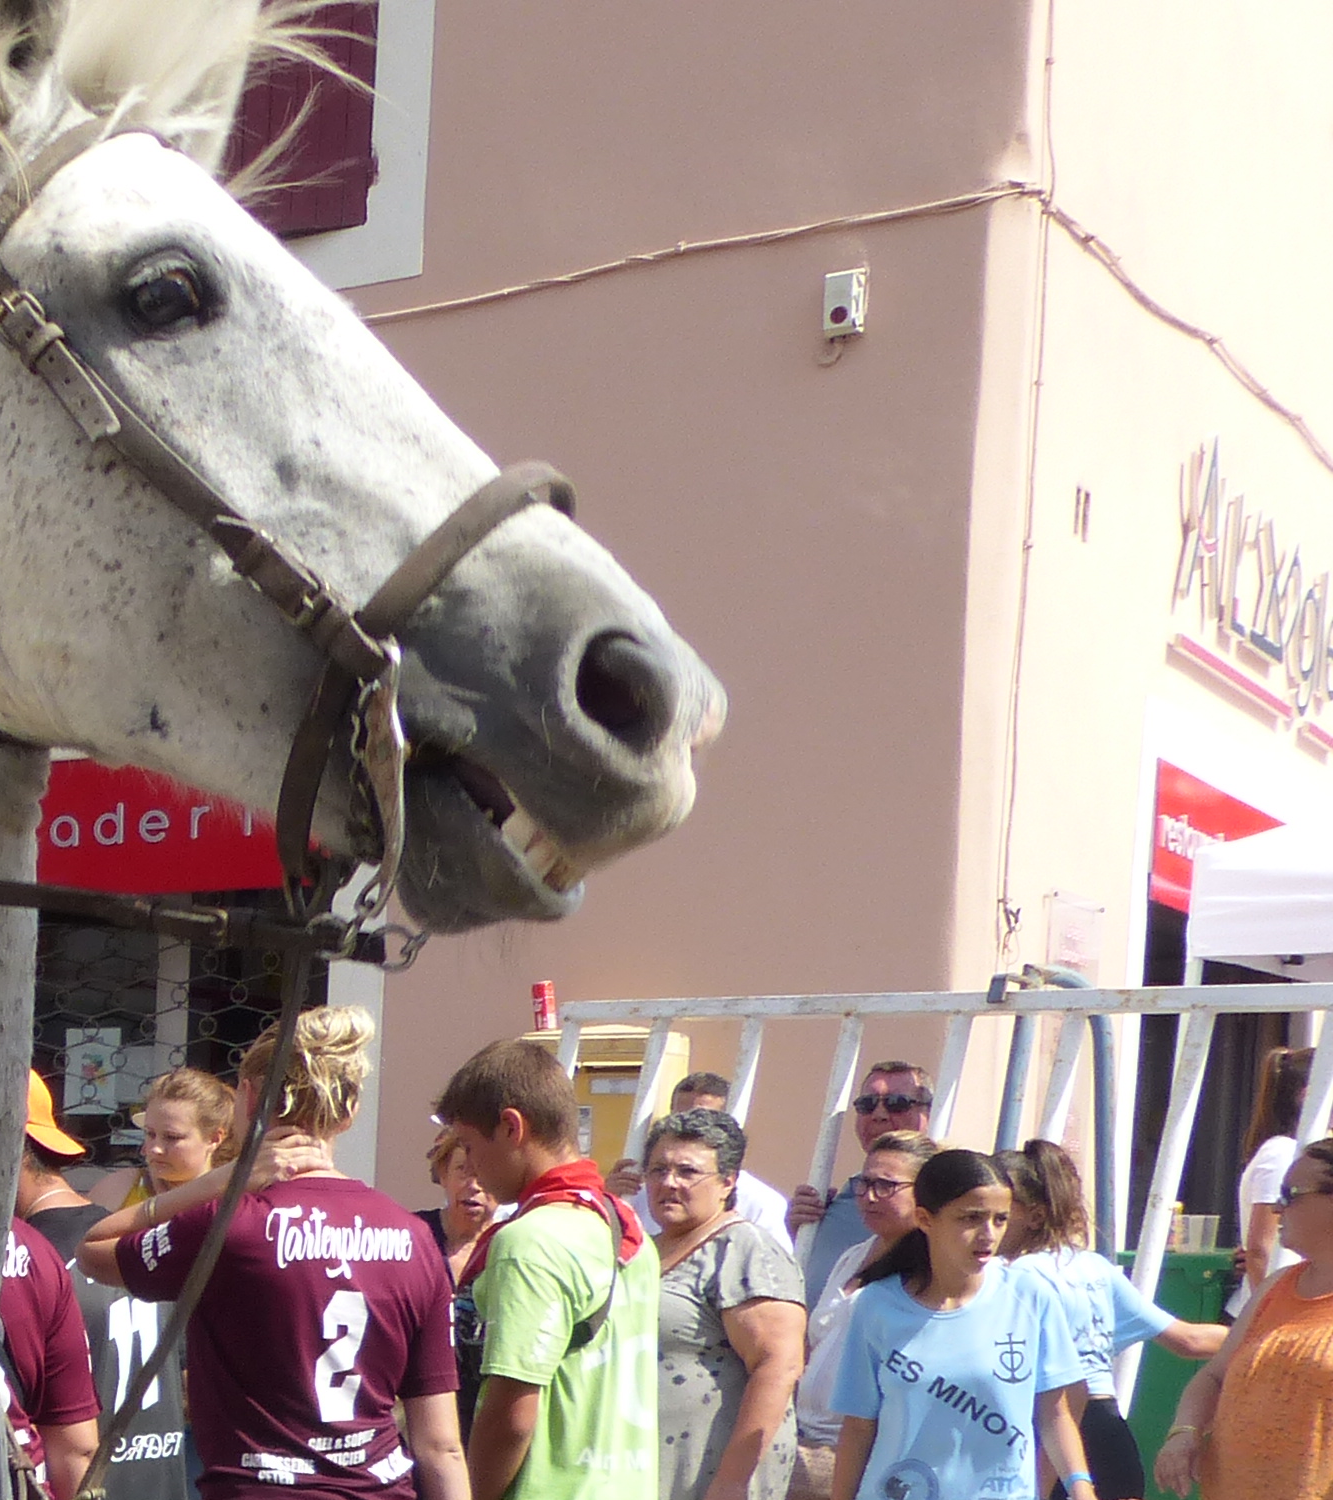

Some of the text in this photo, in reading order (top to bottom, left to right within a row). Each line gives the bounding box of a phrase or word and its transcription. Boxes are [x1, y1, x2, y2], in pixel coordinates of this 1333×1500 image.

[265, 1205, 413, 1280] Tartenpionne
[314, 1289, 369, 1422] 2
[880, 1349, 925, 1384] ES
